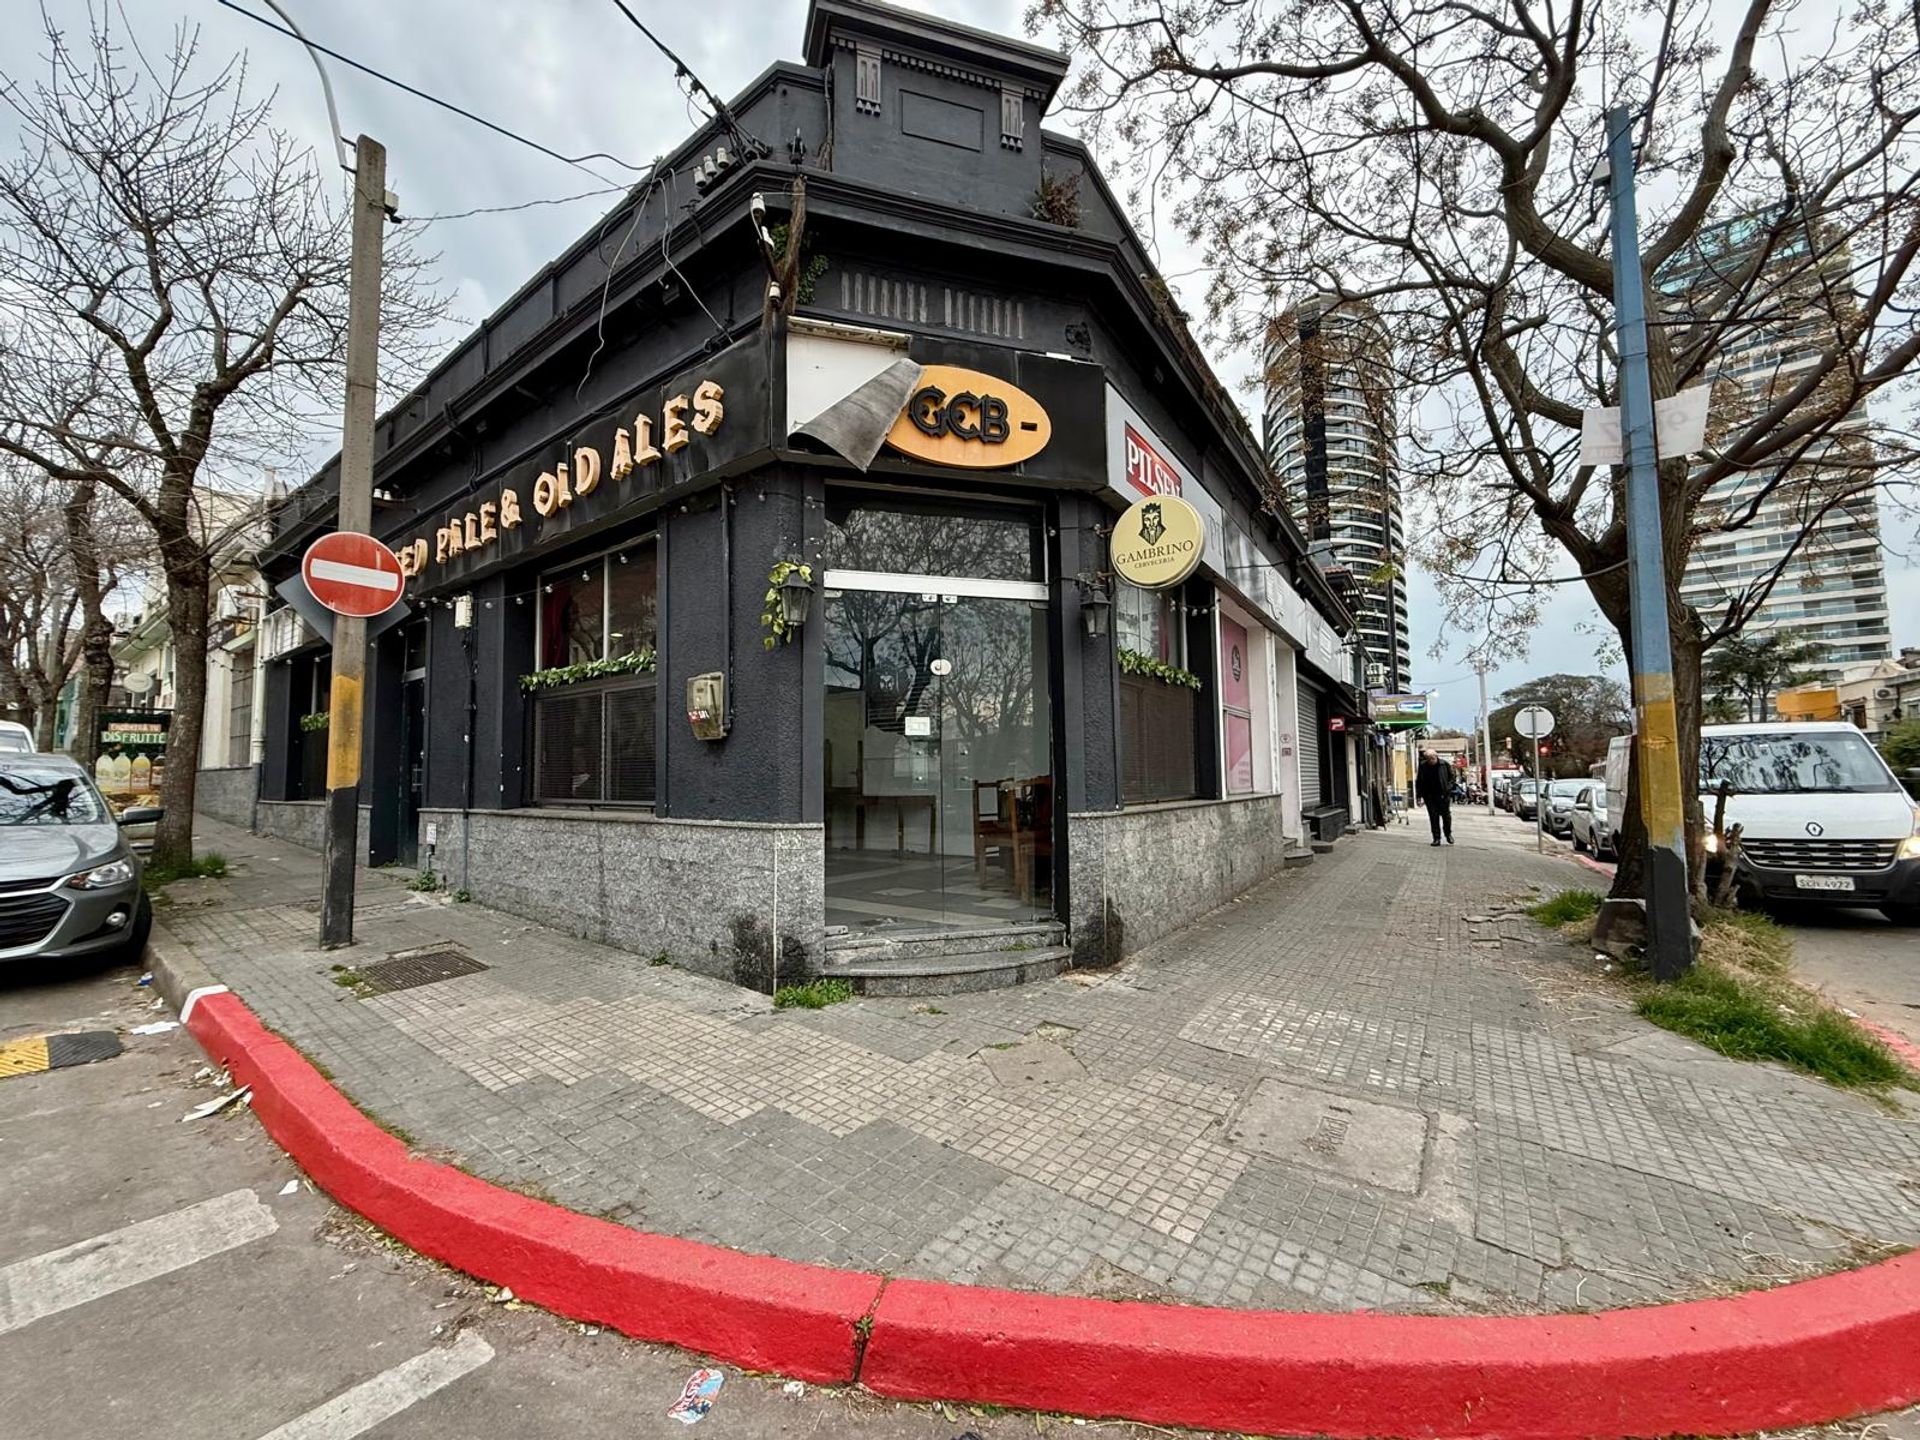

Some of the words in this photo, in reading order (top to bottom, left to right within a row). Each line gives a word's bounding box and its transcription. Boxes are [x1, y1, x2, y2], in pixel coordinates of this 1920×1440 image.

[909, 386, 1010, 443] GCB
[395, 538, 428, 576] ED
[436, 501, 497, 563] PALE
[500, 488, 522, 529] &
[610, 380, 724, 481] ALES
[1116, 540, 1194, 565] GAMBRINO
